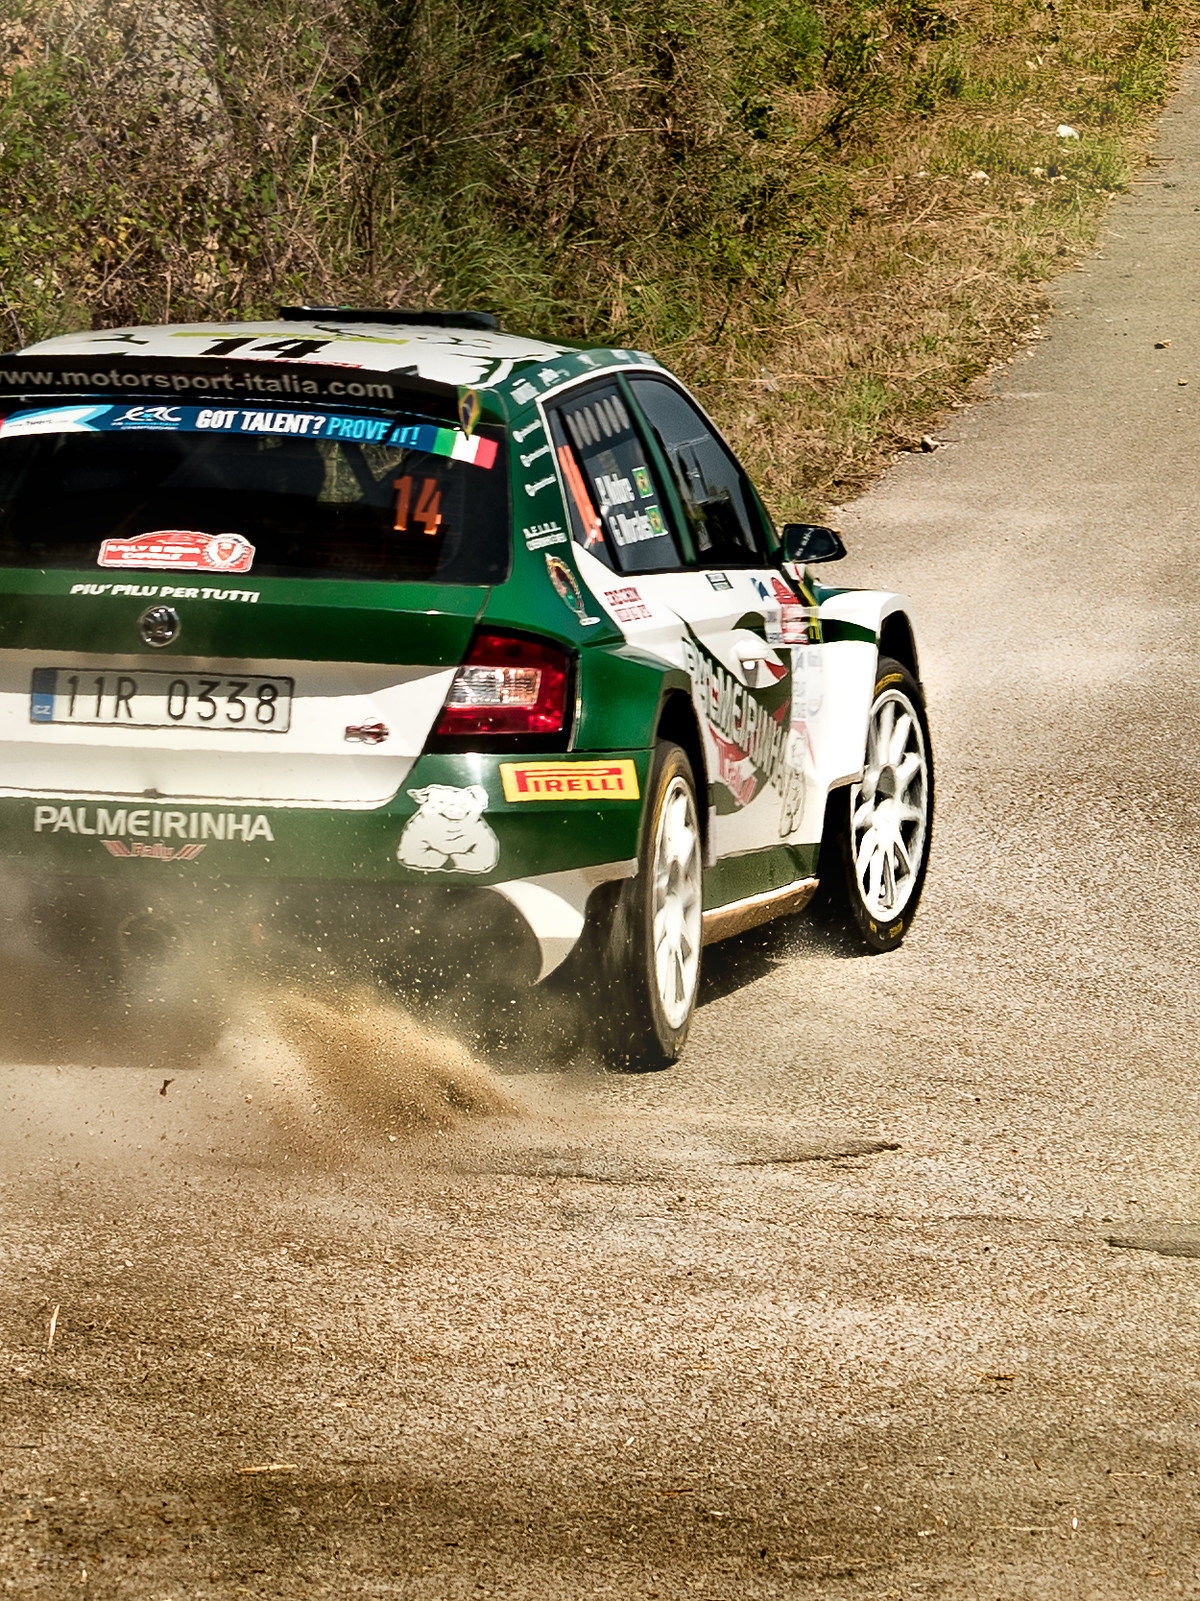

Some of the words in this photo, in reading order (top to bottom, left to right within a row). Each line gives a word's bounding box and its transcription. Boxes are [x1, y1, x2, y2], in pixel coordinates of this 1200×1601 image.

[199, 337, 333, 358] 14
[195, 409, 239, 429] GOT
[241, 411, 326, 435] TALENT?
[393, 475, 442, 535] 14
[111, 584, 160, 597] PILU
[159, 586, 200, 599] PER
[200, 587, 261, 604] TUTTI
[32, 704, 51, 716] CZ
[67, 674, 140, 720] 11R
[167, 678, 279, 725] 0338
[514, 766, 625, 794] PIRELLI
[32, 805, 276, 843] PALMEIRINHA
